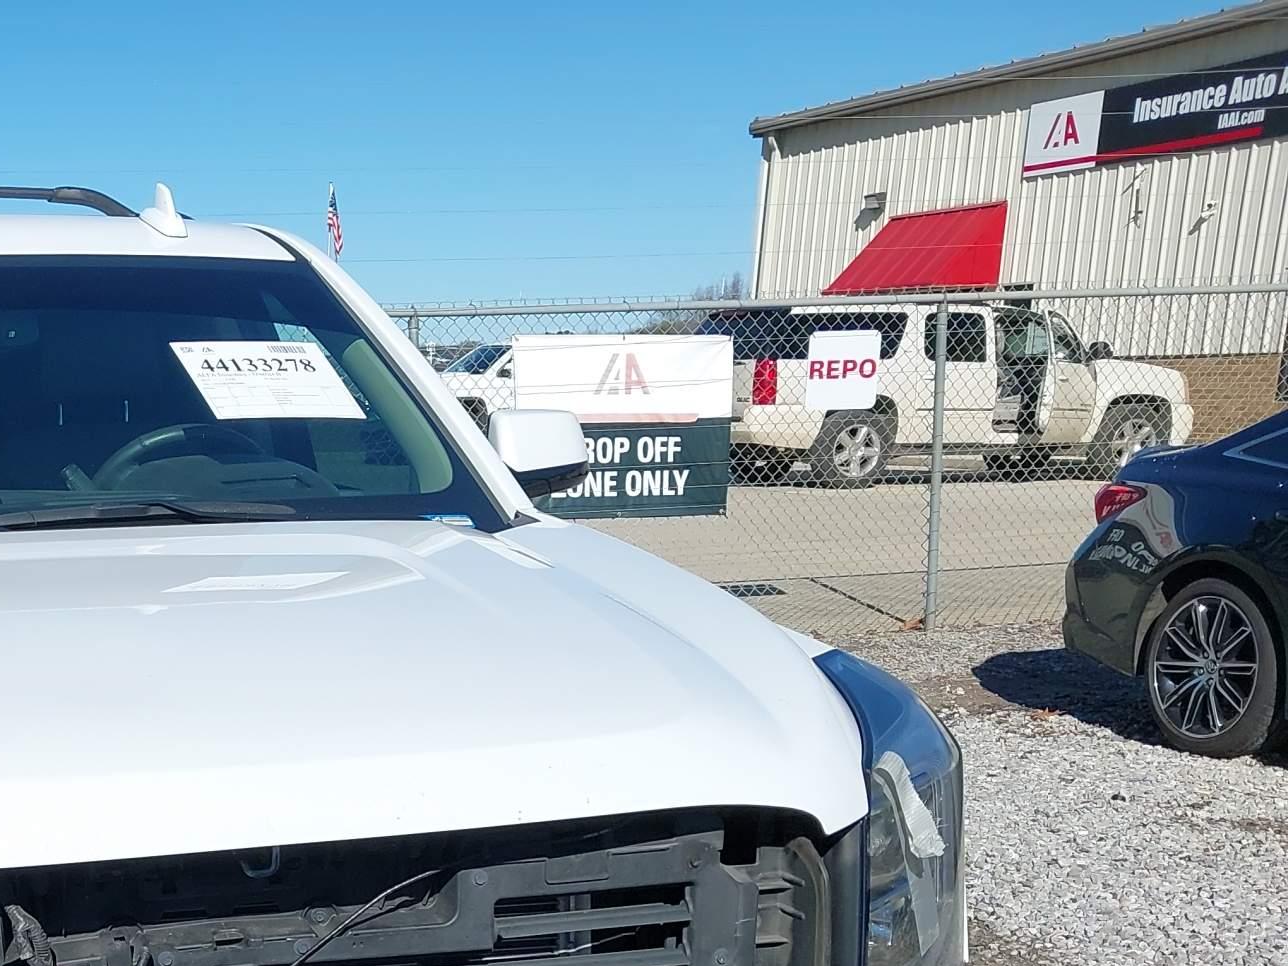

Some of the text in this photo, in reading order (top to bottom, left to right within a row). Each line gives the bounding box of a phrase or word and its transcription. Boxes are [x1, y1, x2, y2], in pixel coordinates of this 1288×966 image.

[1133, 84, 1227, 124] Insurance
[1228, 73, 1277, 105] Auto
[1217, 109, 1265, 129] IAAI.com
[200, 358, 317, 374] 44133278
[809, 359, 877, 379] REPO
[584, 436, 682, 464] ROP OFF
[625, 469, 690, 497] ONLY
